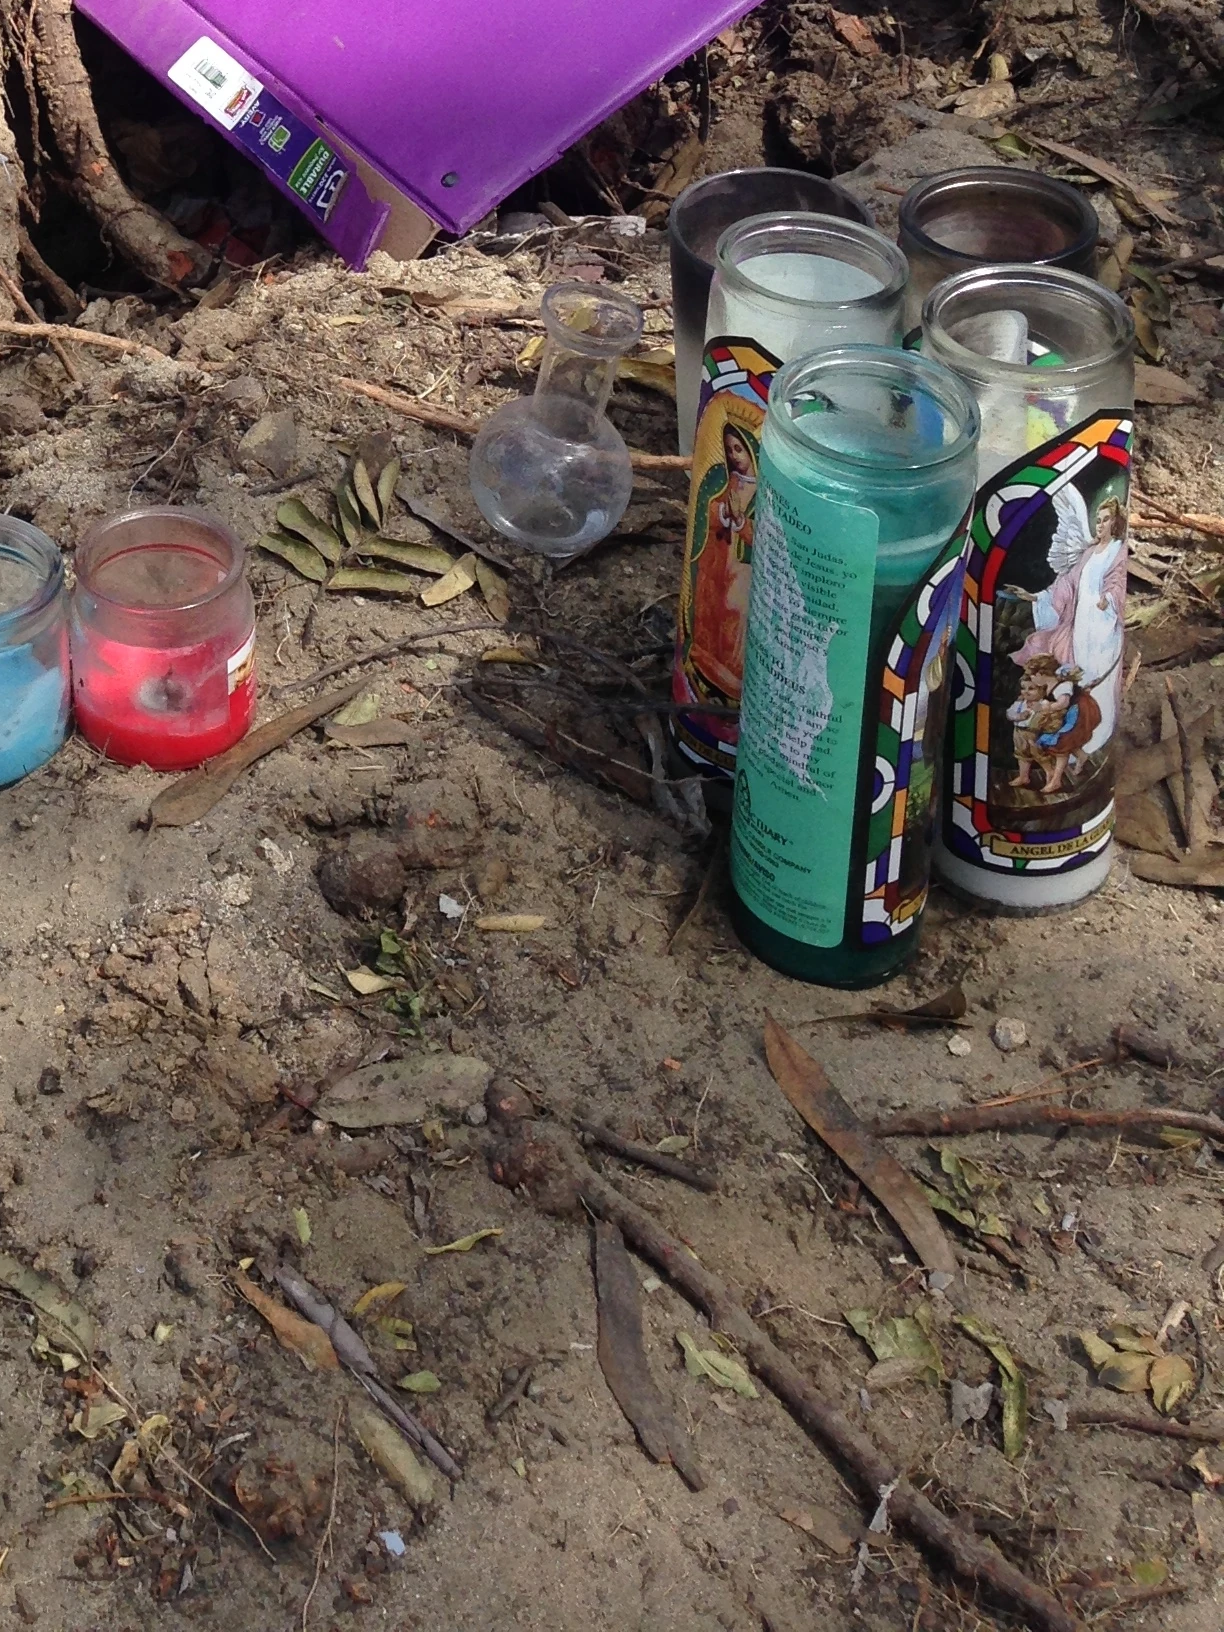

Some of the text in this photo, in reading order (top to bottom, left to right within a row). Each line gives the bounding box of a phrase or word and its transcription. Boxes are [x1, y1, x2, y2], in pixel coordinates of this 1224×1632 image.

[239, 99, 260, 128] AVERY
[300, 150, 330, 194] DURABLE
[791, 506, 800, 517] A
[777, 507, 813, 536] TADEO
[791, 536, 809, 553] San
[842, 570, 858, 581] yo
[801, 580, 837, 599] visible
[785, 730, 808, 748] help
[789, 746, 801, 756] to
[803, 753, 820, 765] my
[824, 770, 836, 779] of
[1009, 846, 1055, 856] ANGEL
[1057, 842, 1074, 850] DE
